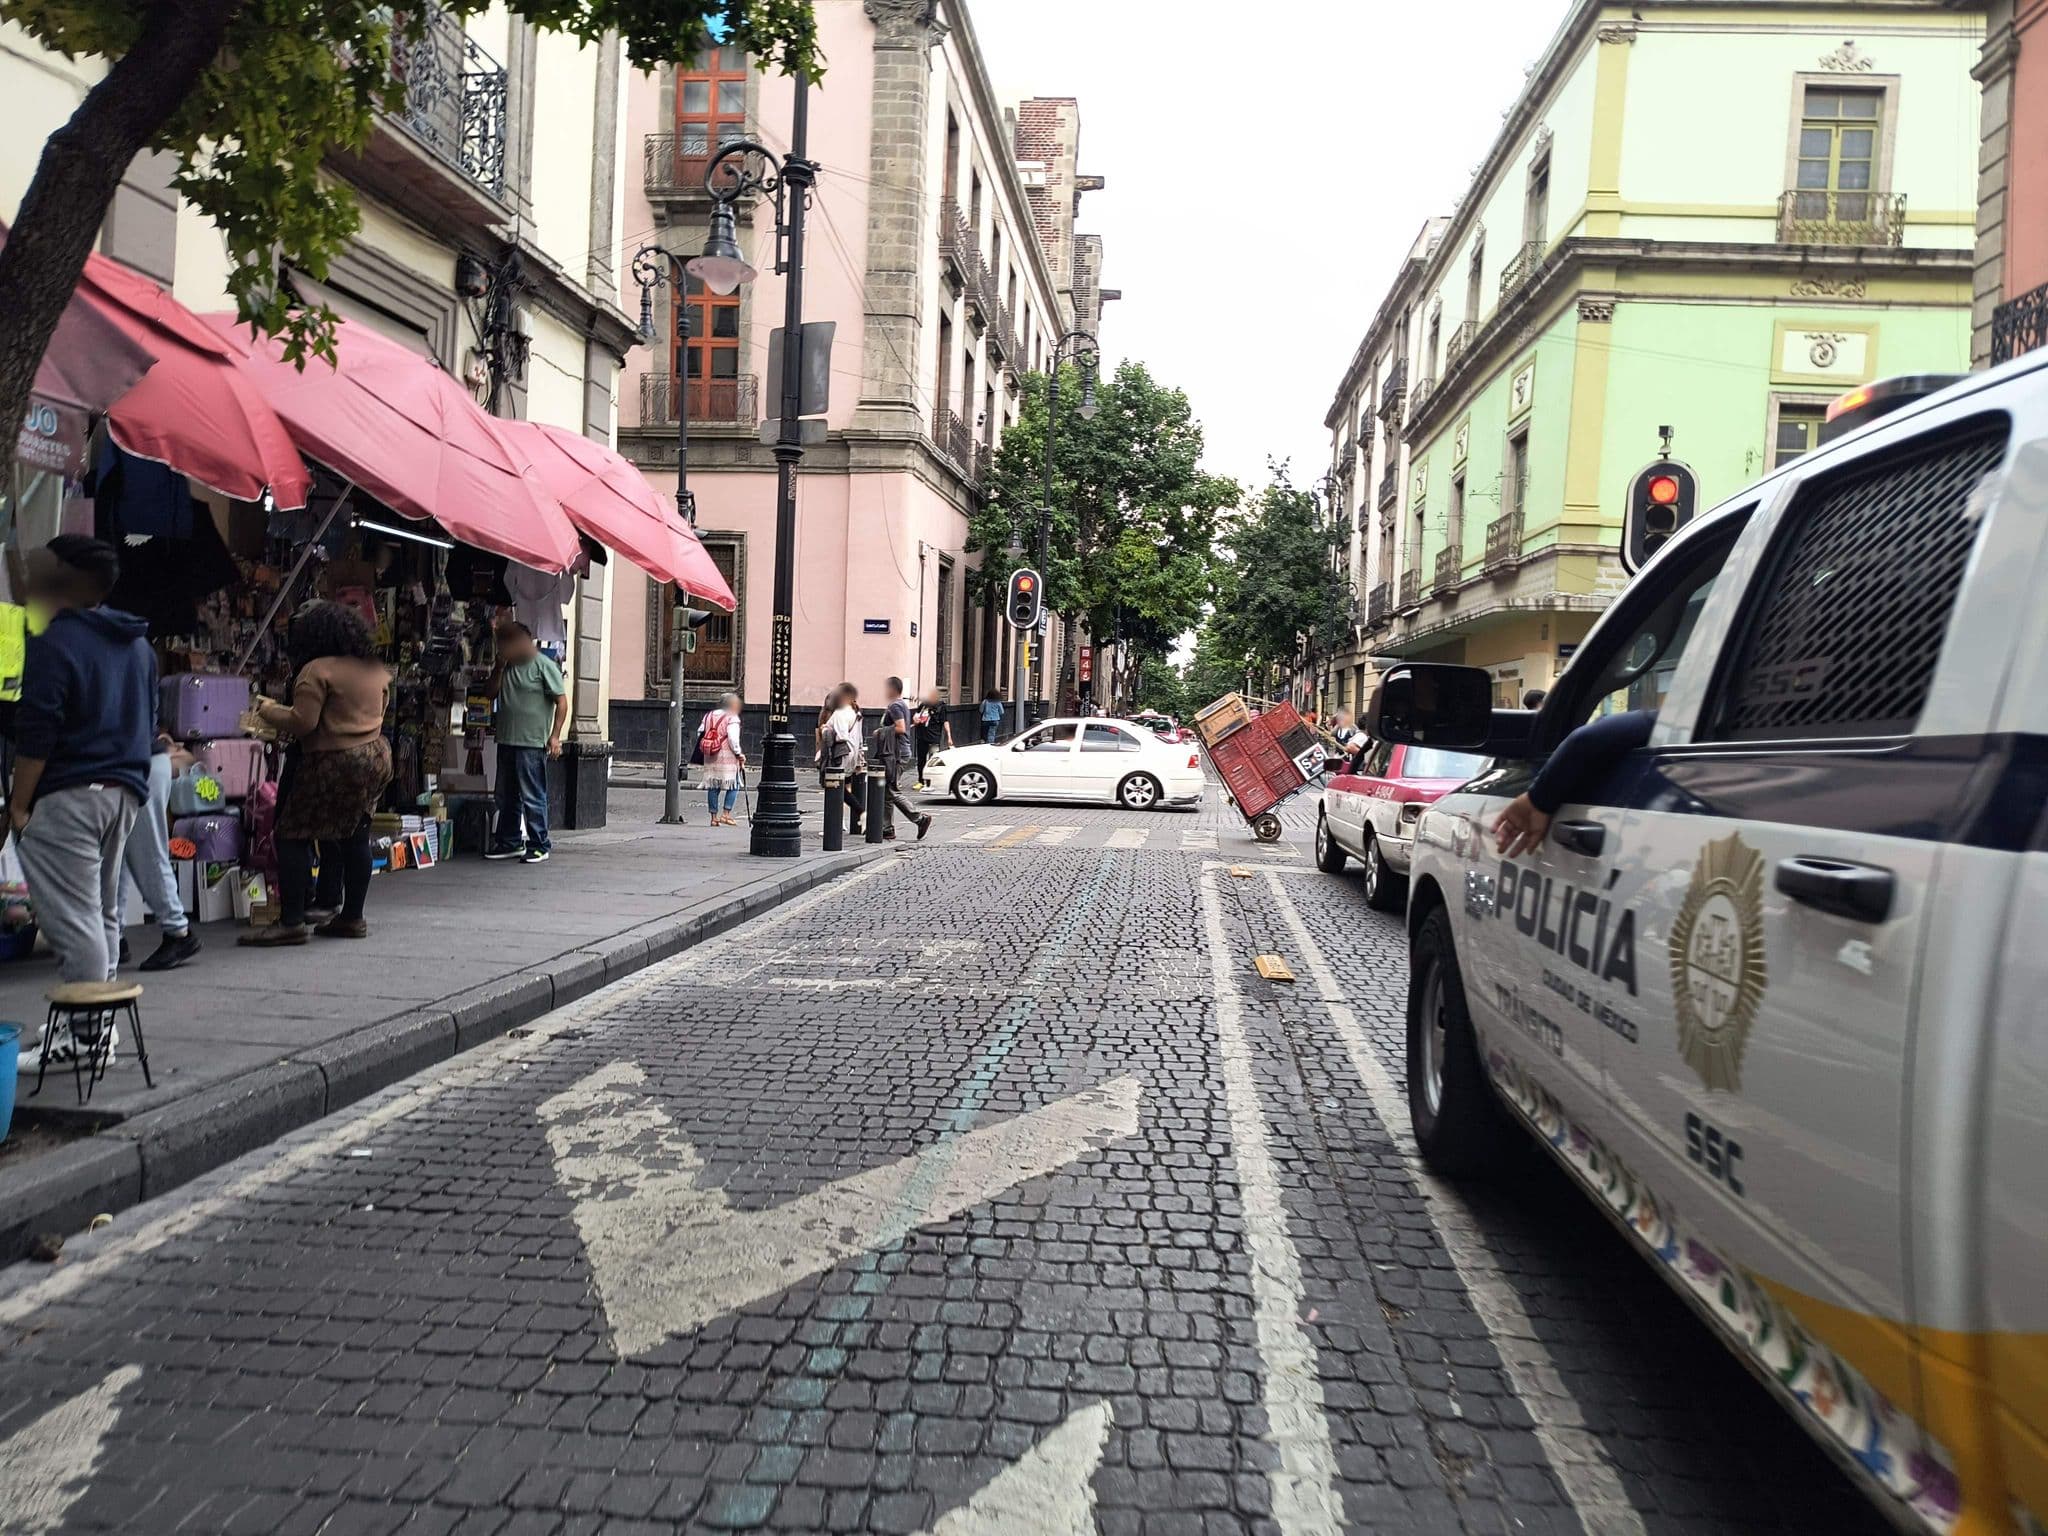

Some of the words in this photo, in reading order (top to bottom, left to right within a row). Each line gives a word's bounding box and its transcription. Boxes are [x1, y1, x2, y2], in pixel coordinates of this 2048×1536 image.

[1749, 666, 1818, 696] SSC
[1496, 859, 1639, 998] POLICÍA
[1686, 1111, 1745, 1198] SSC
